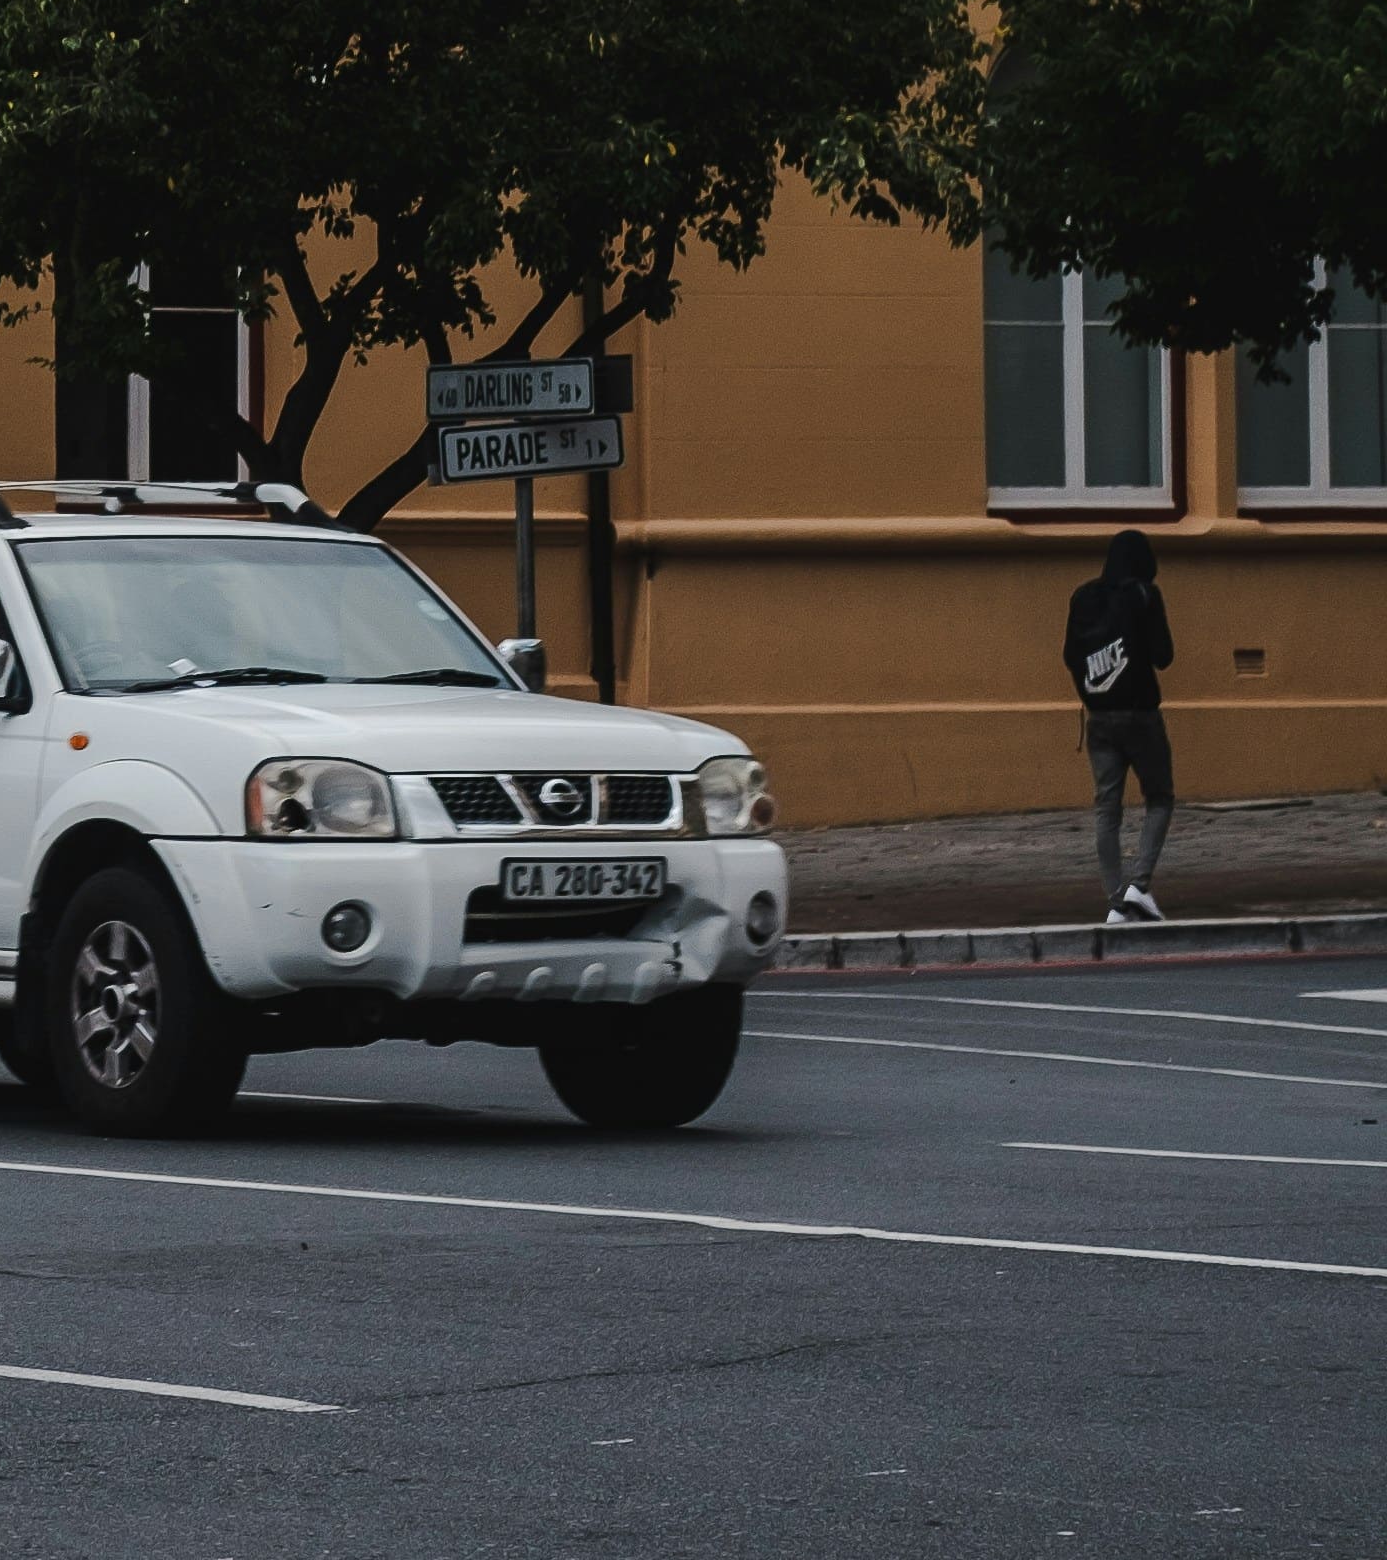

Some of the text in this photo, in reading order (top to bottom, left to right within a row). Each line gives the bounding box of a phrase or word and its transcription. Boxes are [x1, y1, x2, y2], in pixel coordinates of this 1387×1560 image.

[465, 372, 533, 408] DARLING
[540, 371, 553, 392] ST
[456, 432, 548, 471] PARADE
[560, 430, 576, 449] ST
[1087, 637, 1124, 680] NIKE
[511, 865, 544, 896] CA
